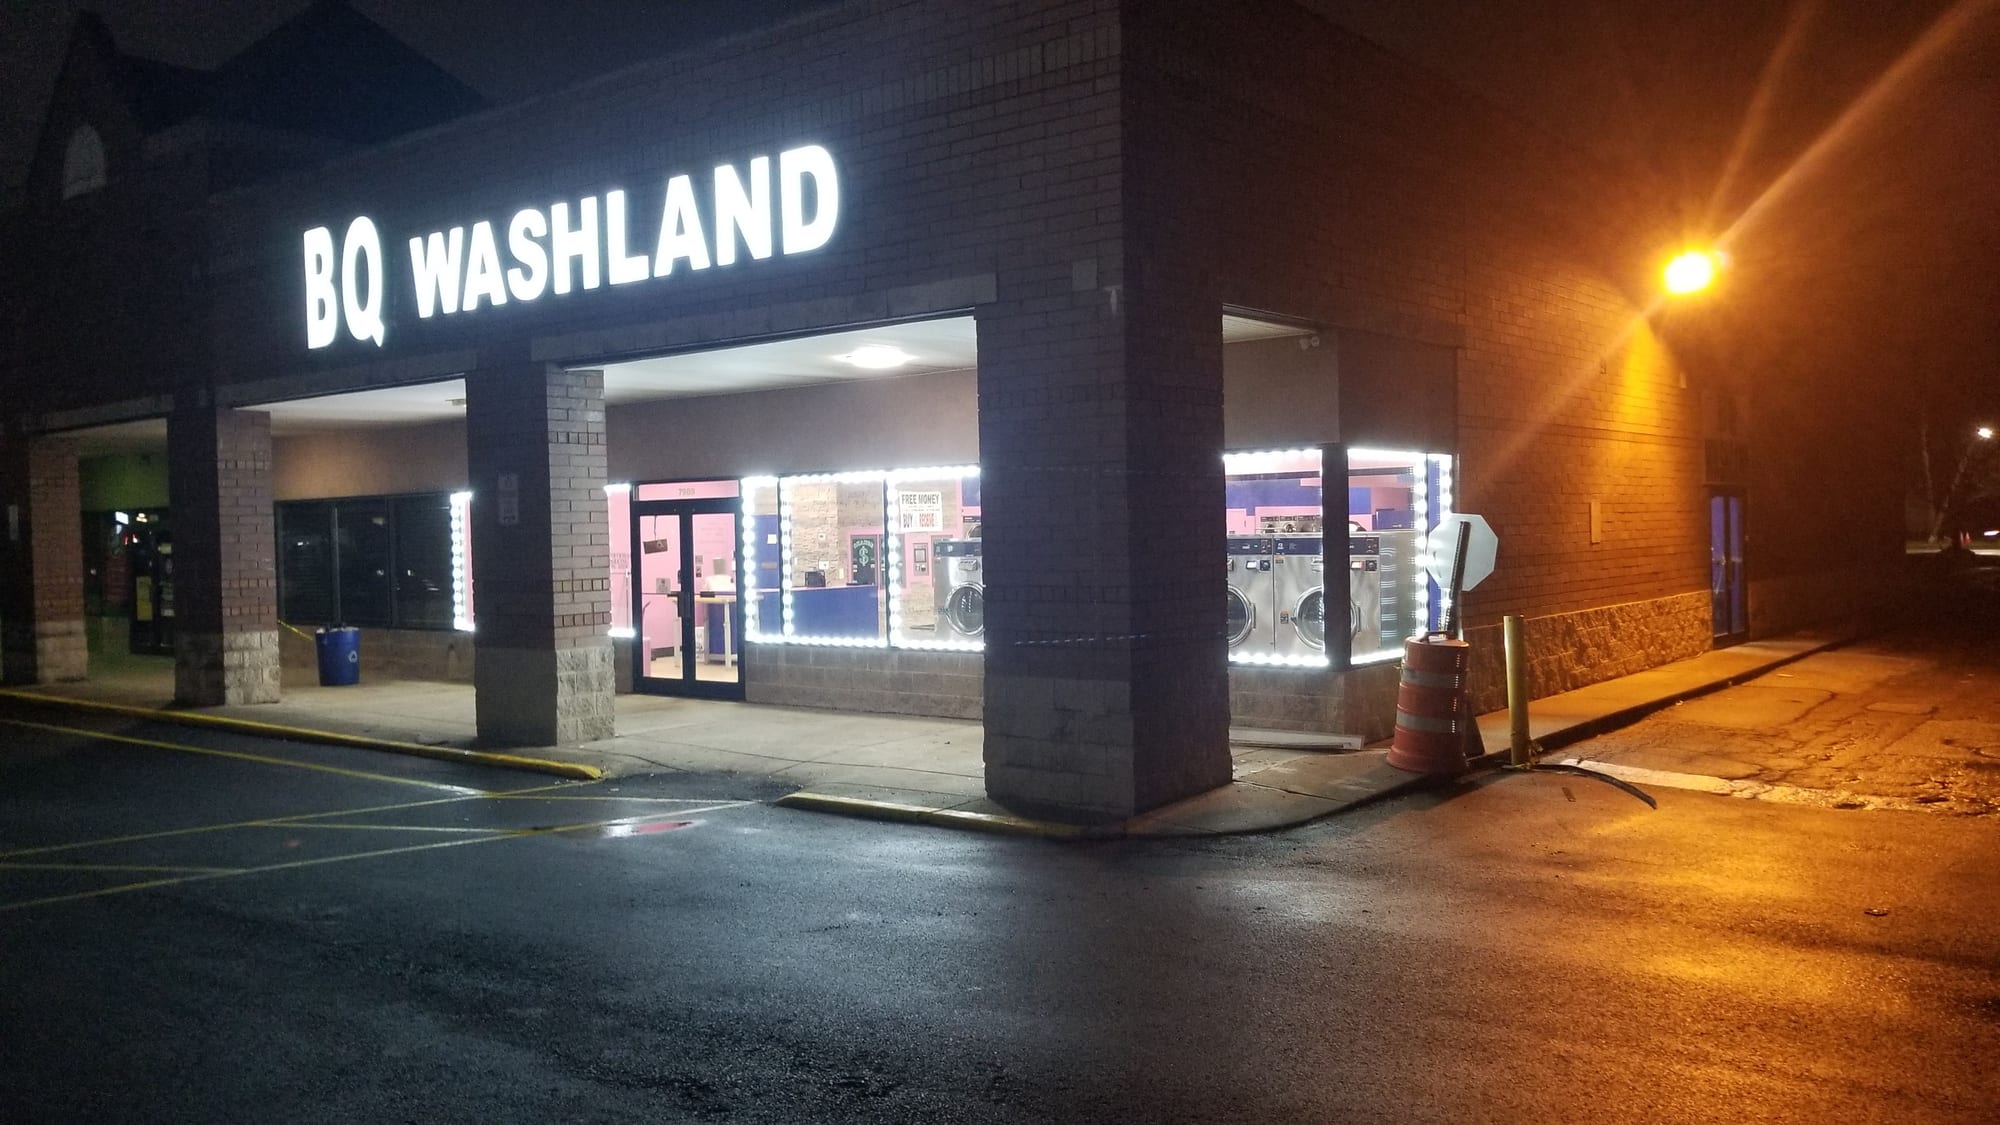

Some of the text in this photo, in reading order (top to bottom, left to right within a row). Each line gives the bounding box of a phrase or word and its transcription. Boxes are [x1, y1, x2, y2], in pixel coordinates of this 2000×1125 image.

[304, 144, 839, 349] BQ WASHLAND
[901, 494, 939, 504] FREE MONEY
[903, 513, 913, 528] BUY
